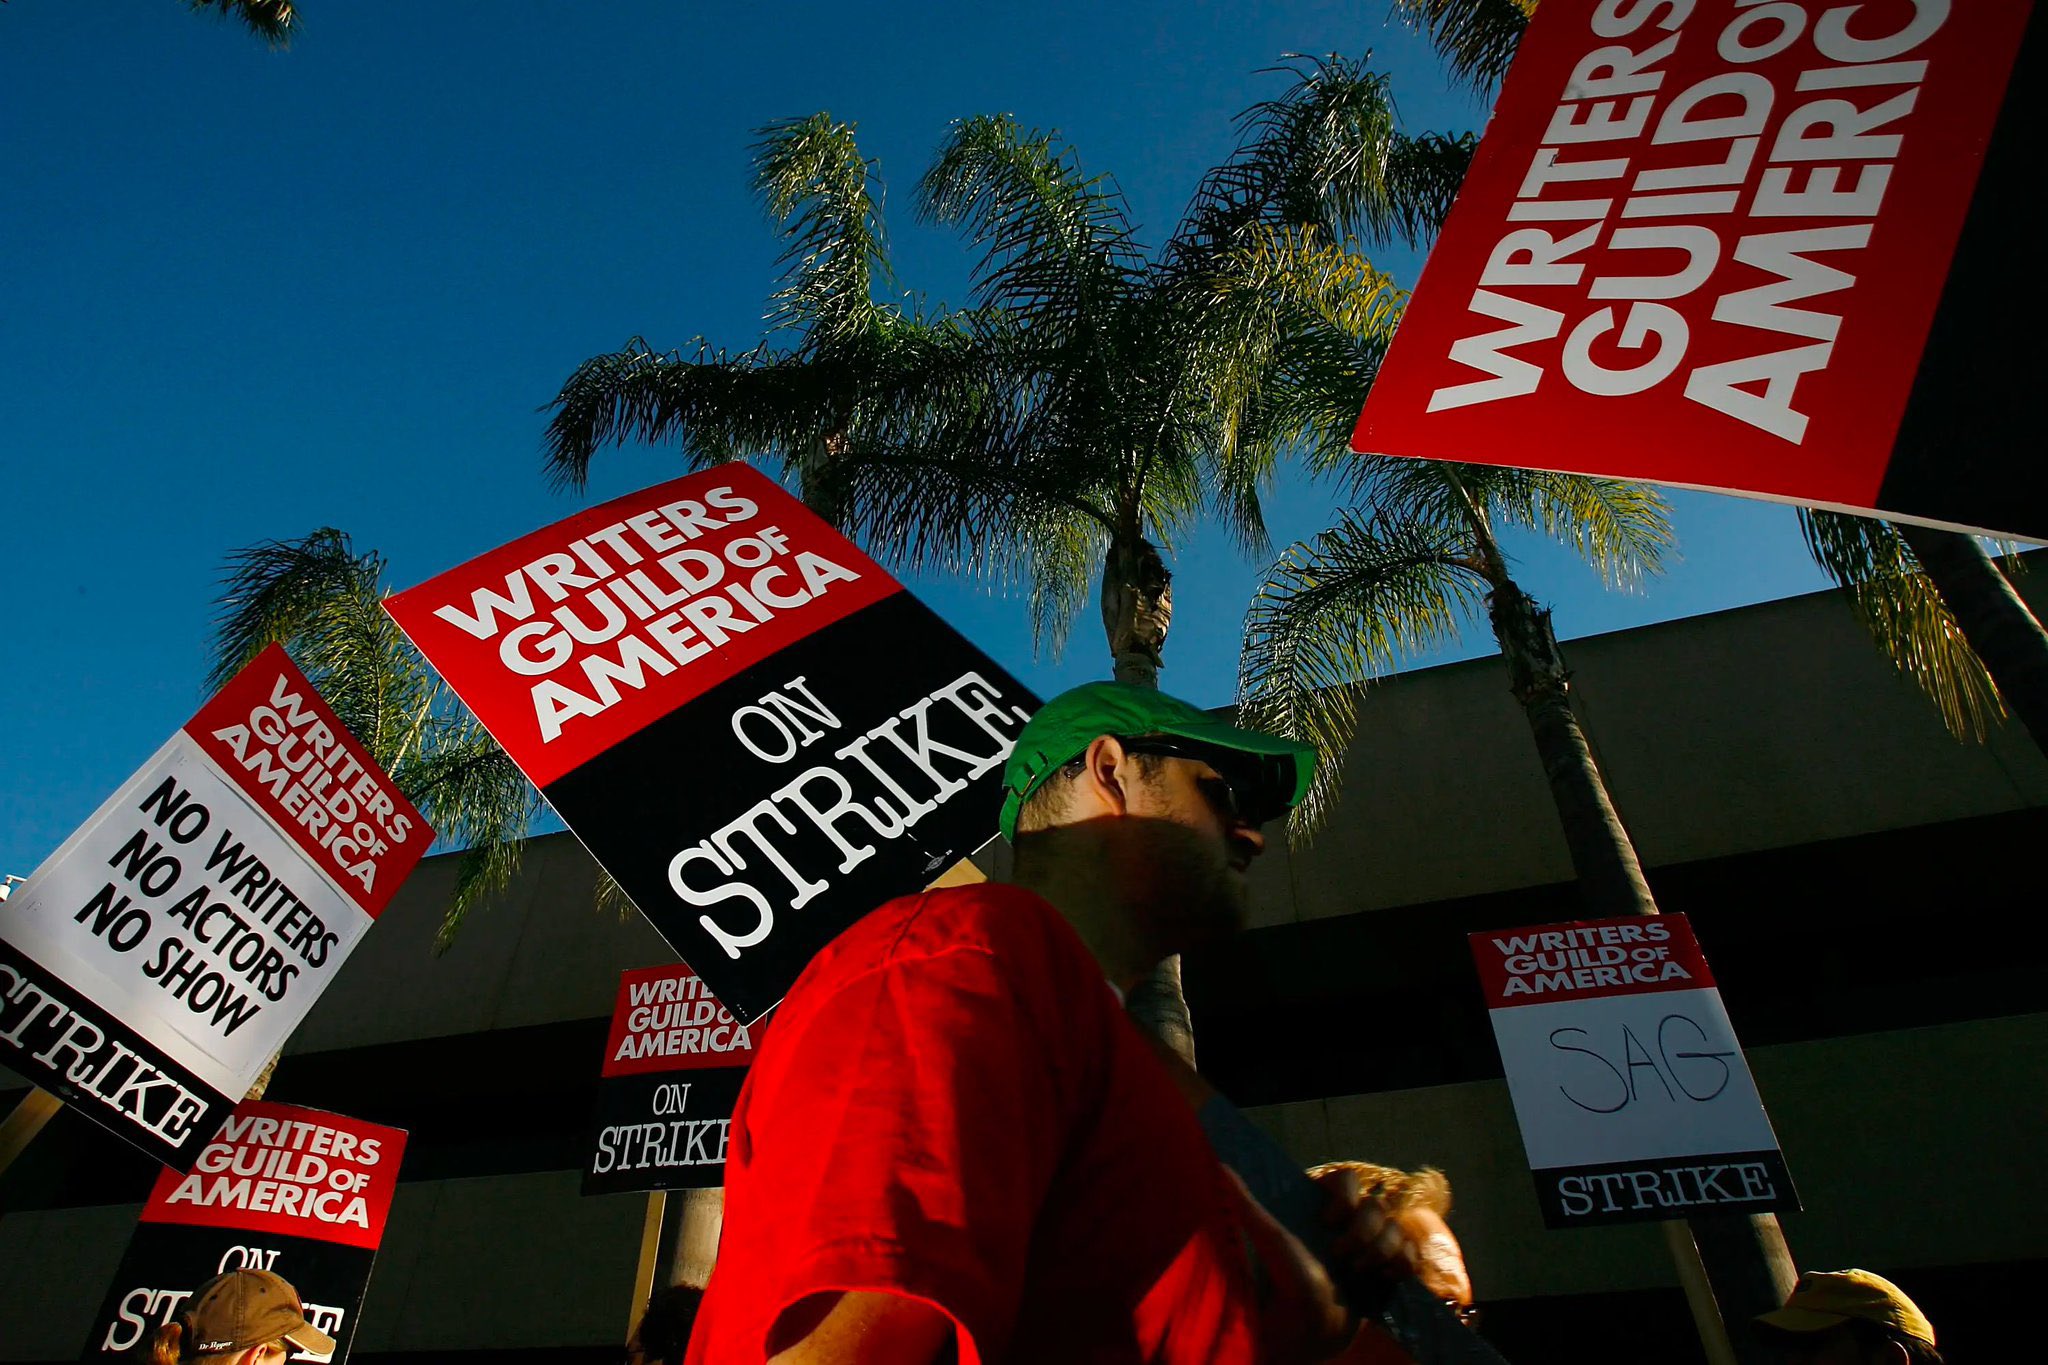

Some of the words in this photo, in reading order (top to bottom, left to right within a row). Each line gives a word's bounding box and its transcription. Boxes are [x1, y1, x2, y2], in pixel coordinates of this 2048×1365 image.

[1426, 0, 1697, 414] WRITERS
[1561, 72, 1777, 397] GUILD
[1717, 0, 1808, 64] O
[1683, 0, 1952, 446] AMERIC
[432, 486, 759, 641] WRITERS
[499, 549, 726, 677] GUILD
[724, 525, 790, 568] OF
[530, 551, 863, 744] AMERICA
[731, 675, 842, 764] ON
[211, 723, 377, 895] AMERICA
[249, 705, 358, 823] GUILD
[353, 822, 389, 857] OF
[269, 673, 413, 844] WRITERS
[668, 671, 1032, 959] STRIKE
[107, 828, 182, 898] NO
[166, 884, 301, 1002] ACTORS
[138, 775, 211, 845] NO
[204, 828, 340, 969] WRITERS
[1492, 922, 1671, 955] WRITERS
[73, 881, 152, 953] NO
[141, 936, 262, 1038] SHOW
[628, 1000, 716, 1033] GUILD
[717, 1005, 735, 1025] O
[630, 975, 714, 1007] WRITE
[1502, 961, 1692, 997] AMERICA
[1504, 946, 1627, 975] GUILD
[1631, 946, 1671, 962] OF
[0, 963, 210, 1149] TRIKE
[614, 1025, 752, 1061] AMERICA
[652, 1083, 692, 1116] ON
[1550, 1014, 1736, 1114] SAG
[164, 1174, 369, 1229] AMERICA
[195, 1143, 329, 1185] GUILD
[328, 1168, 371, 1194] OF
[1558, 1162, 1777, 1216] STRIKE
[198, 1343, 209, 1351] Dr
